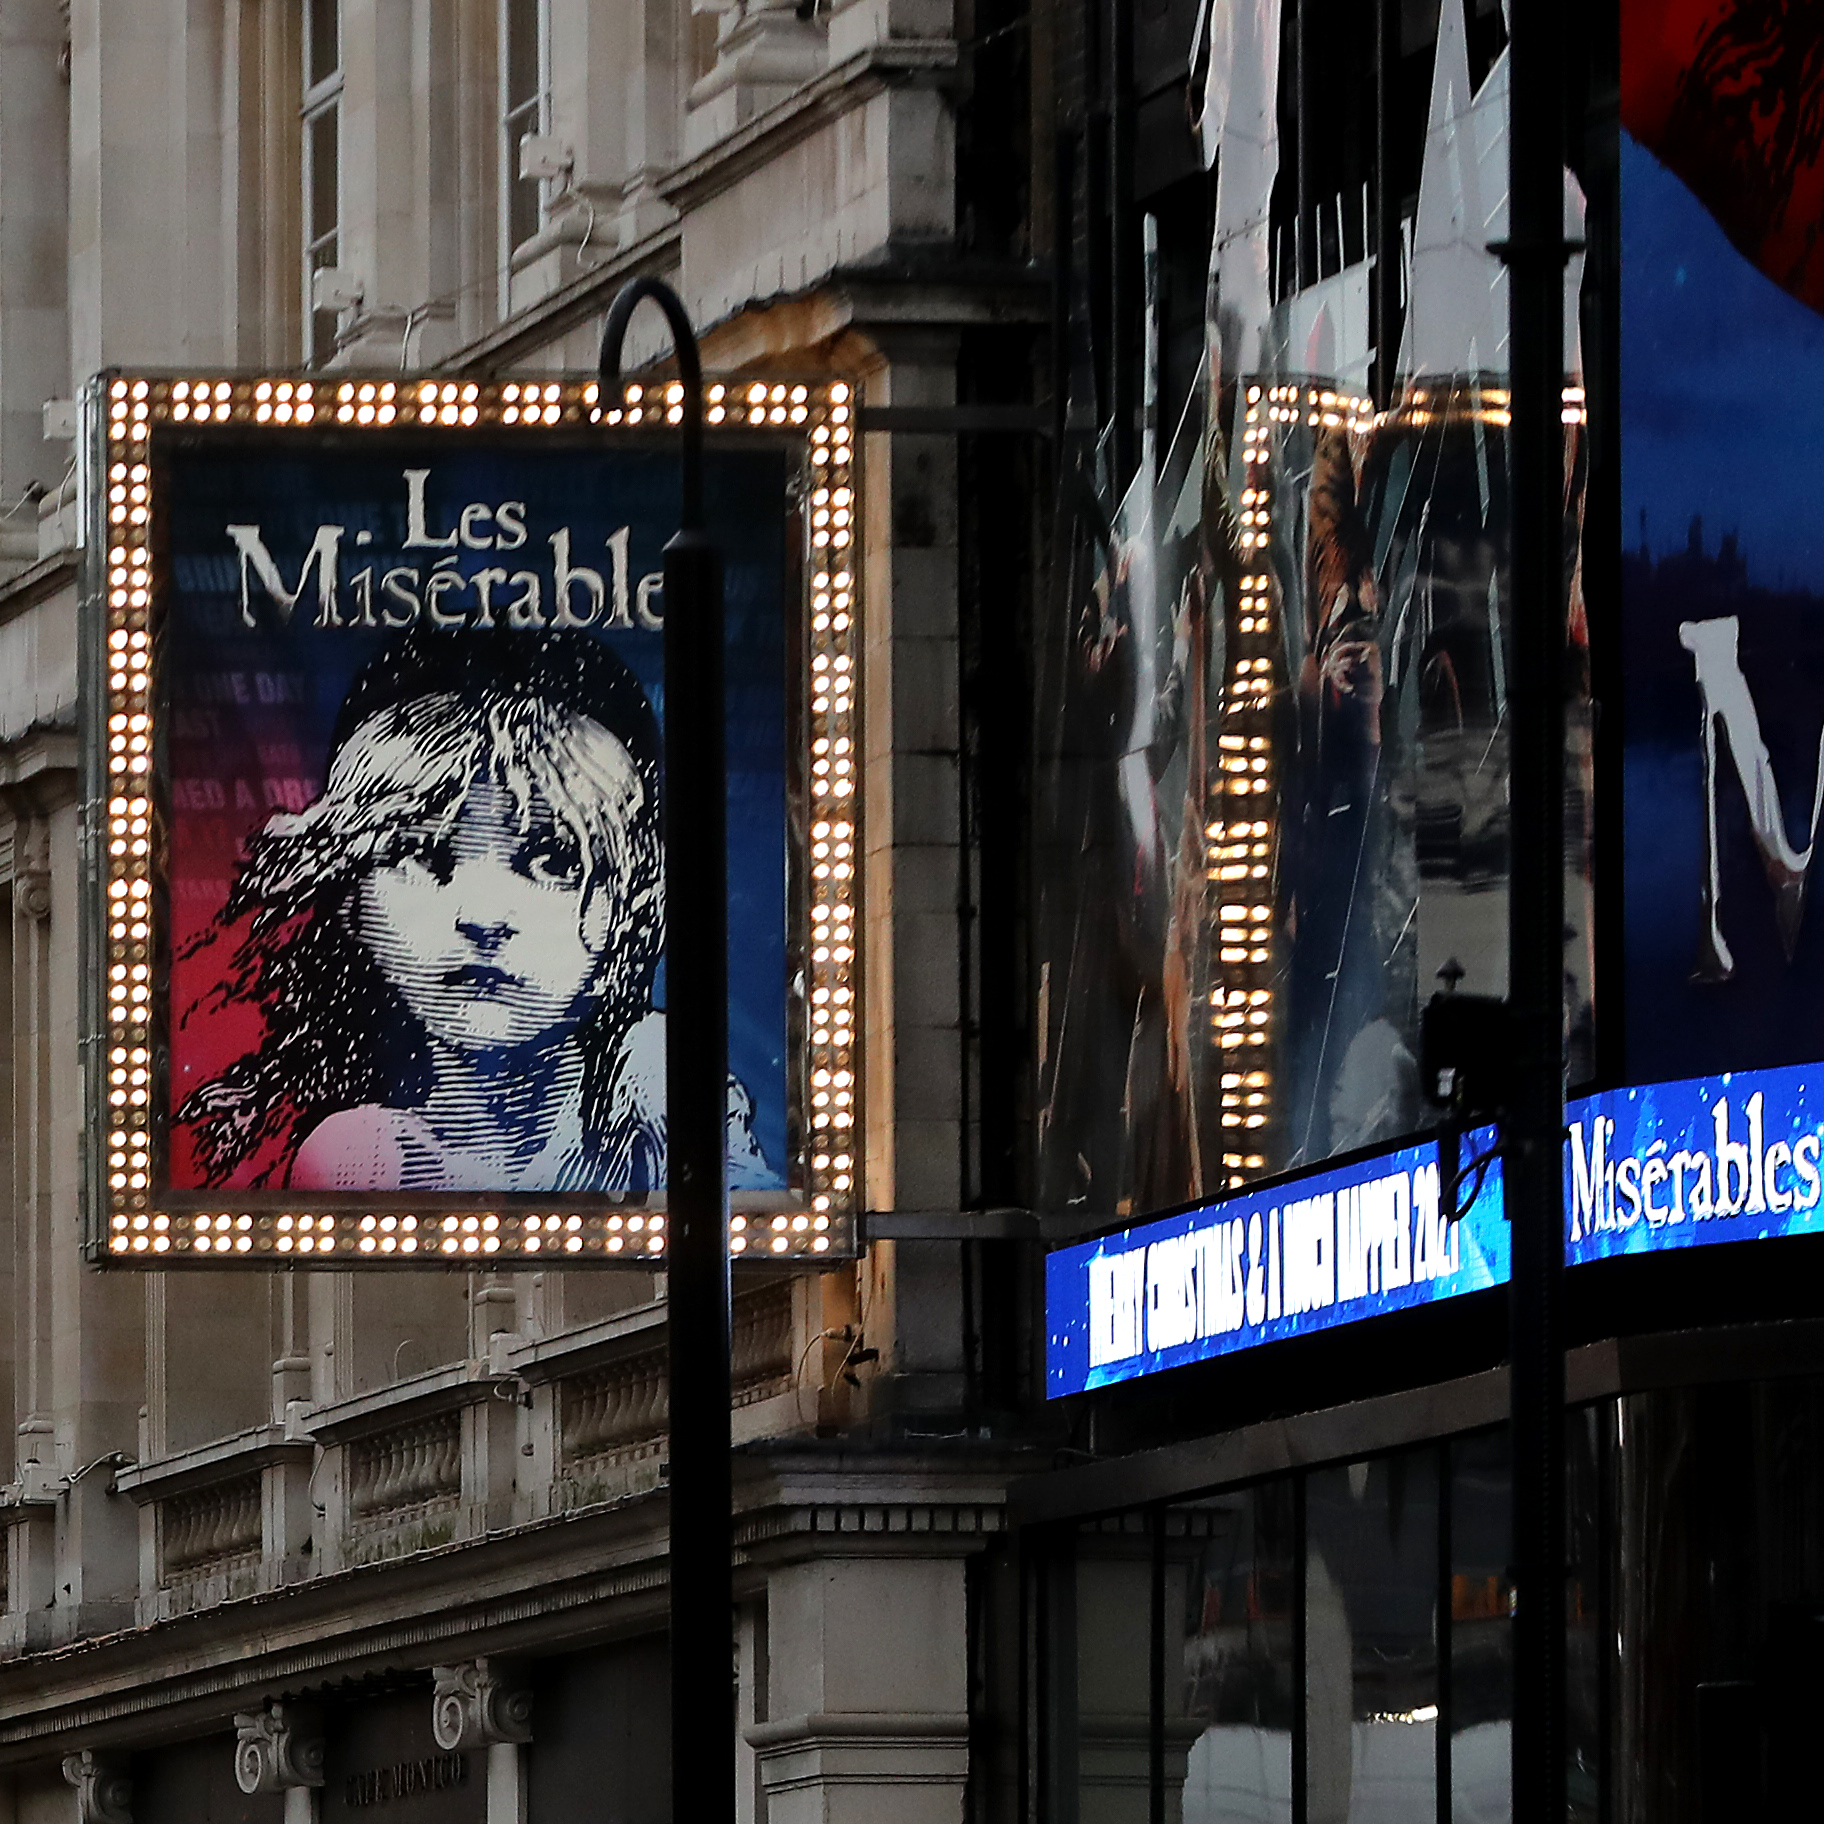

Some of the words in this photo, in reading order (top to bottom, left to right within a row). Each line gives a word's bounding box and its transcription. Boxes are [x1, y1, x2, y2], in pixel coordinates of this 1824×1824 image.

[401, 468, 529, 551] Les
[226, 523, 664, 631] Misérable
[1568, 1090, 1822, 1243] Misérables
